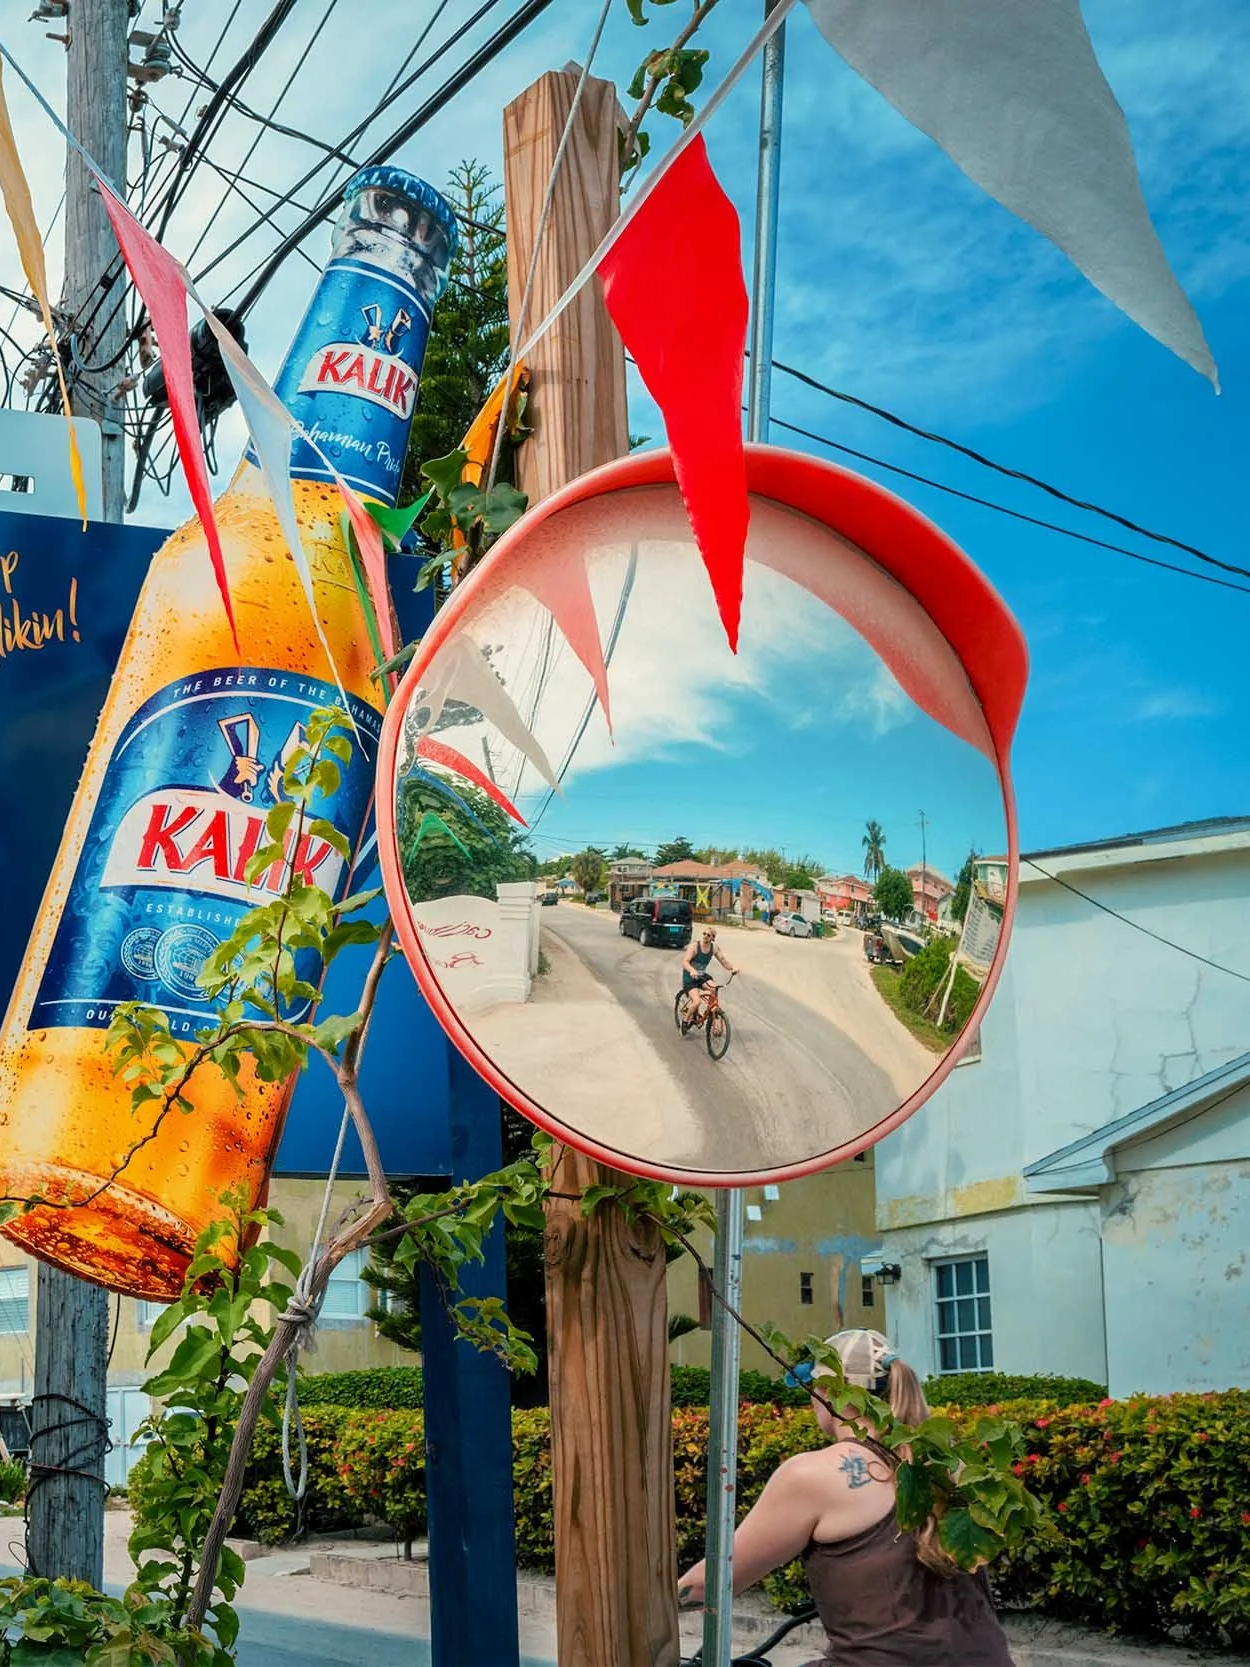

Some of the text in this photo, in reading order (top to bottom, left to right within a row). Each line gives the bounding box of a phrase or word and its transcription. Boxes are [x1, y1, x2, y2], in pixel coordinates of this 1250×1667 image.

[318, 351, 414, 414] KALIK
[377, 441, 401, 472] Prid
[173, 676, 381, 733] THE BEER OF THE BHAMAS
[146, 903, 241, 926] ESTABLISHE
[86, 1009, 114, 1021] OU
